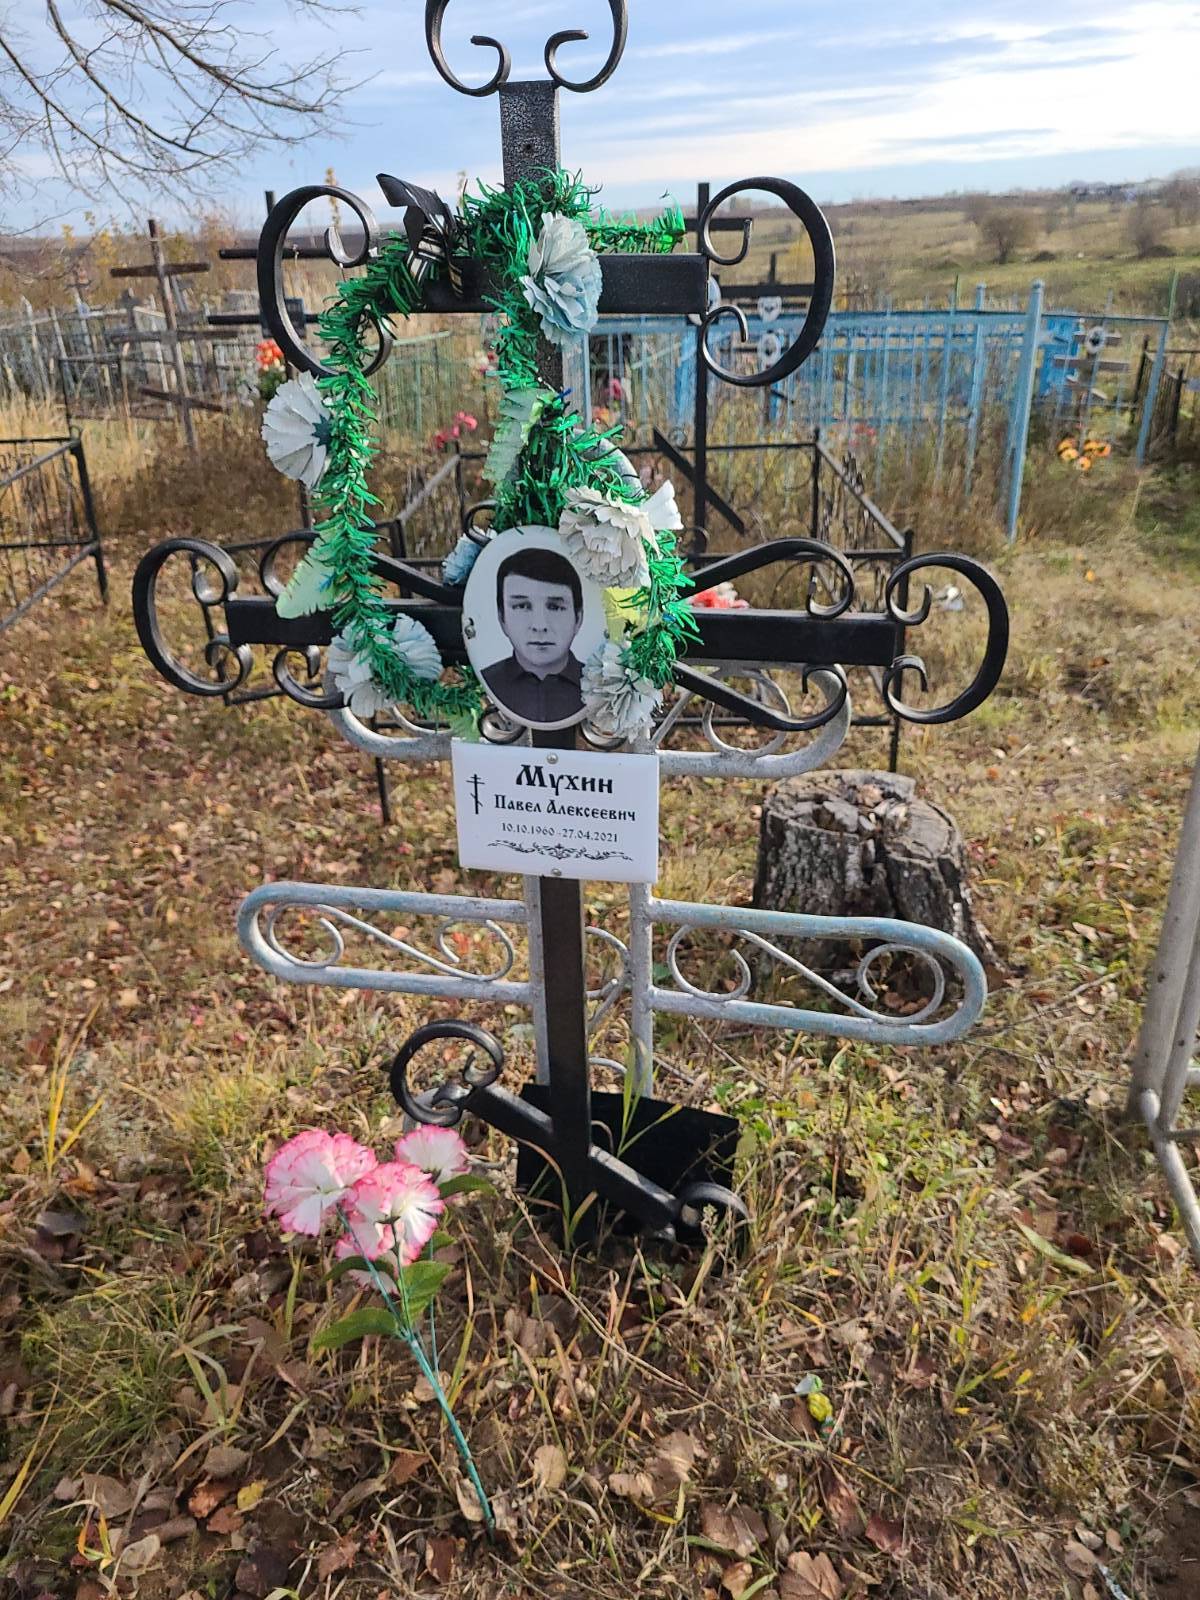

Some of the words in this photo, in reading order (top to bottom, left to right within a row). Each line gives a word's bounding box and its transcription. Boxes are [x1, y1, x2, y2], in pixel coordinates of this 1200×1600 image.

[515, 764, 613, 796] Мухин
[494, 794, 542, 814] Павел
[547, 799, 636, 821] Алексеевич
[501, 822, 555, 837] 10.10.1960
